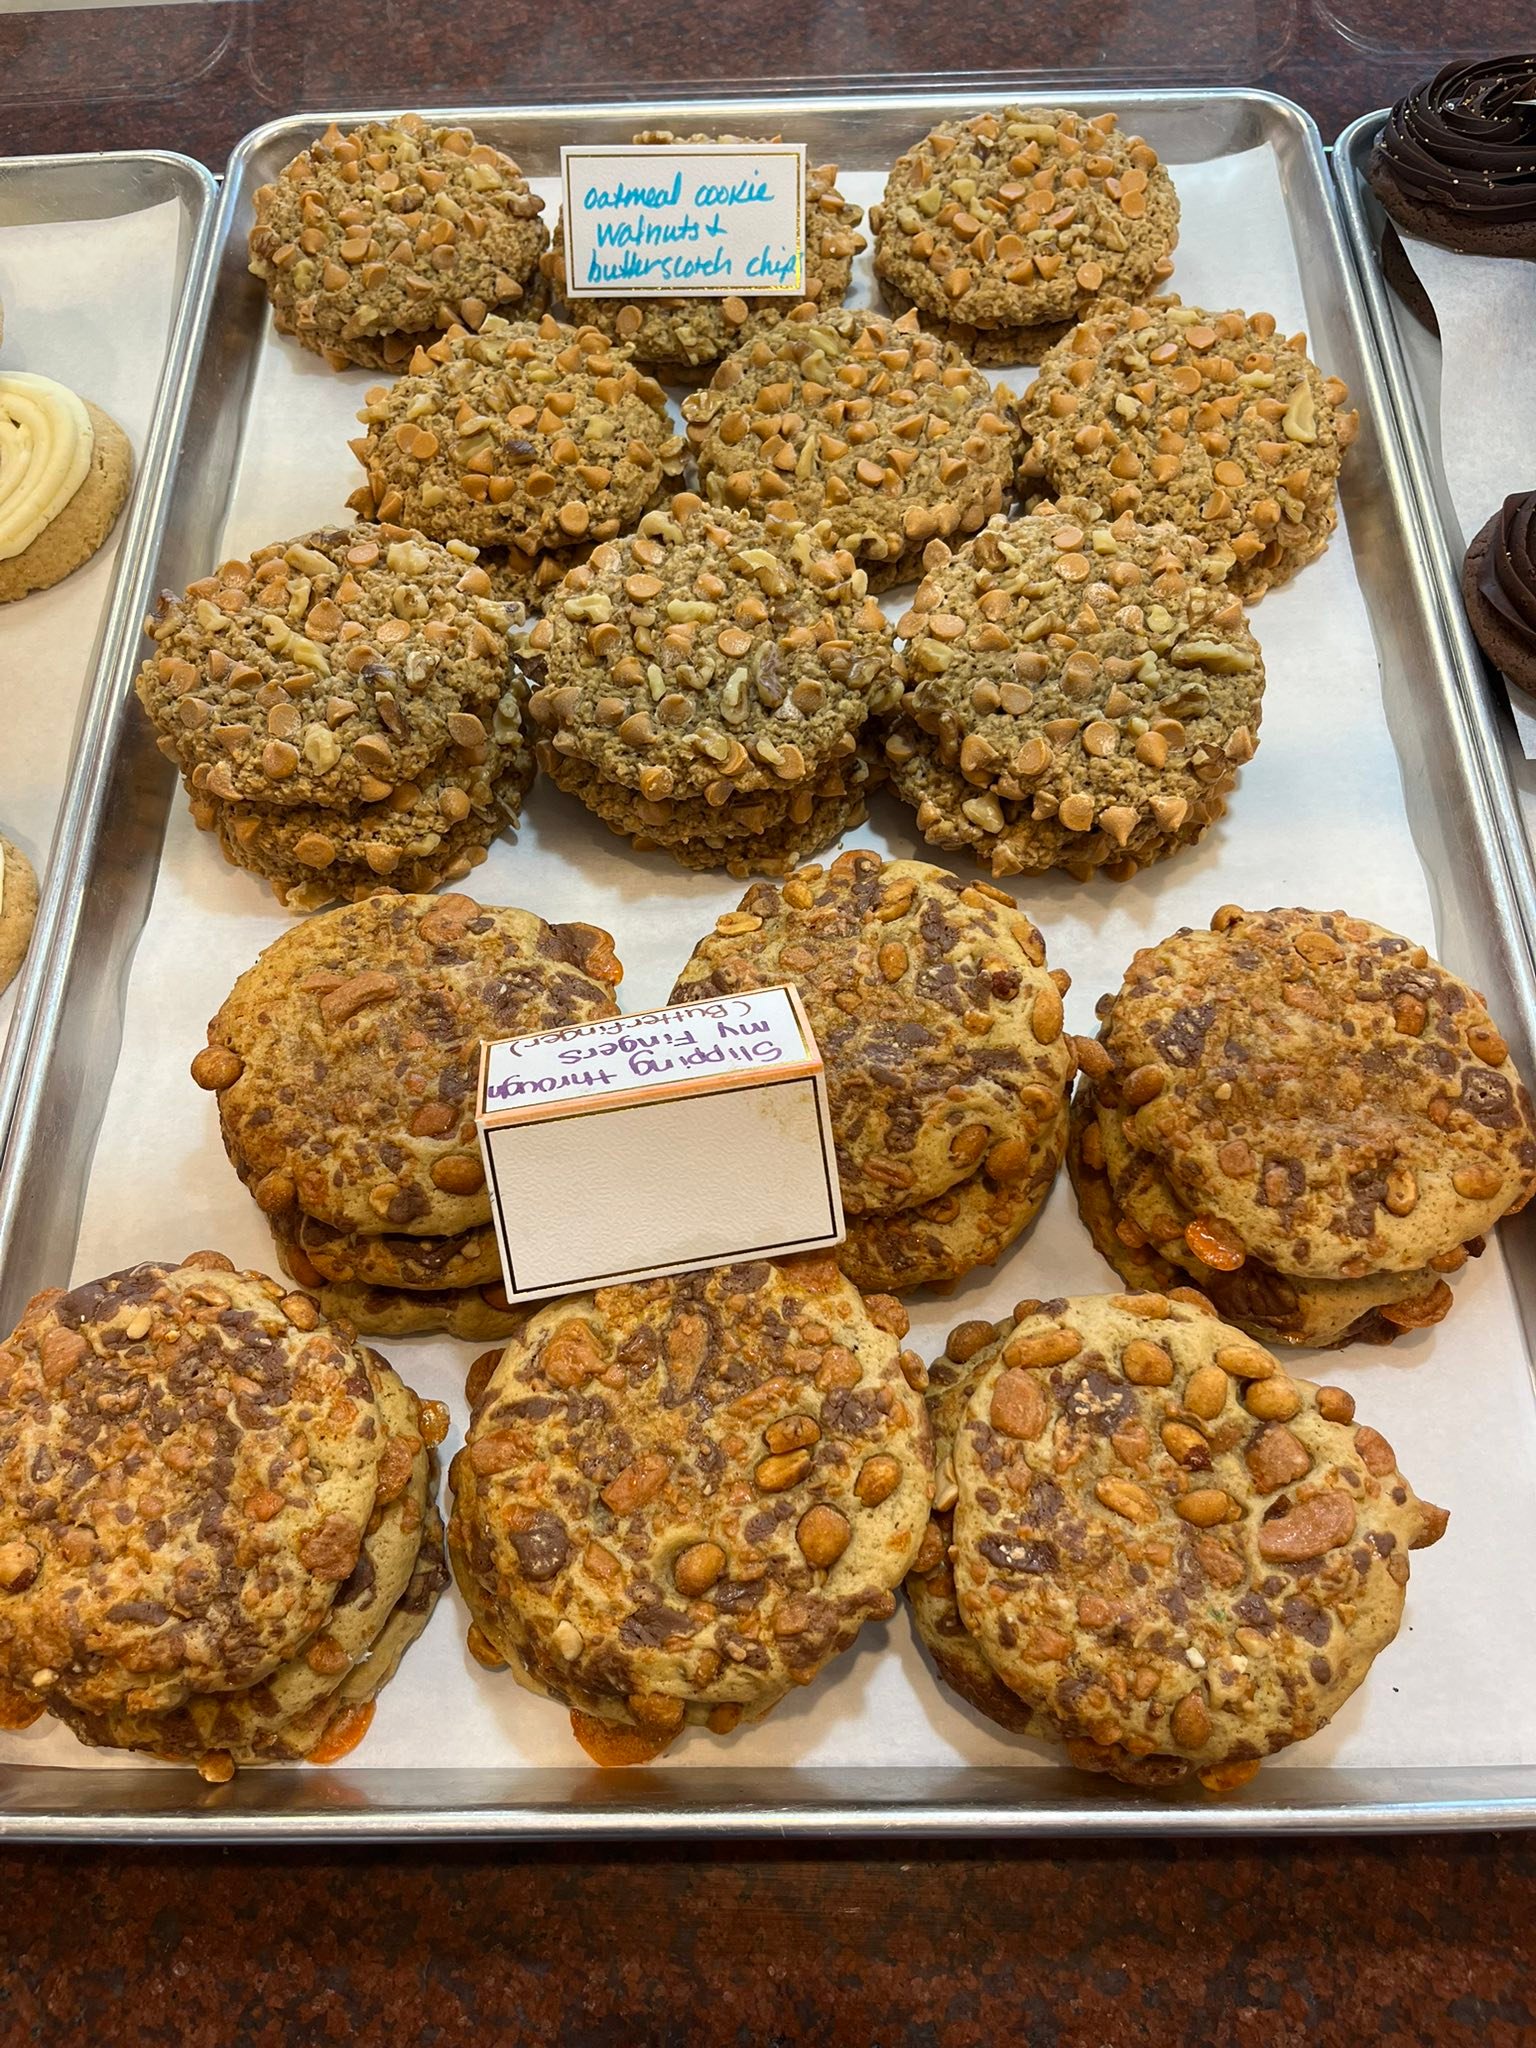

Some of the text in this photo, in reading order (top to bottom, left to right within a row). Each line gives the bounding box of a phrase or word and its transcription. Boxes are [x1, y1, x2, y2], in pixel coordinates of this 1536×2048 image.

[584, 170, 774, 209] oatmeal cookie
[588, 247, 732, 283] butterscotch
[718, 1020, 769, 1038] my
[487, 1041, 783, 1099] Slipping through
